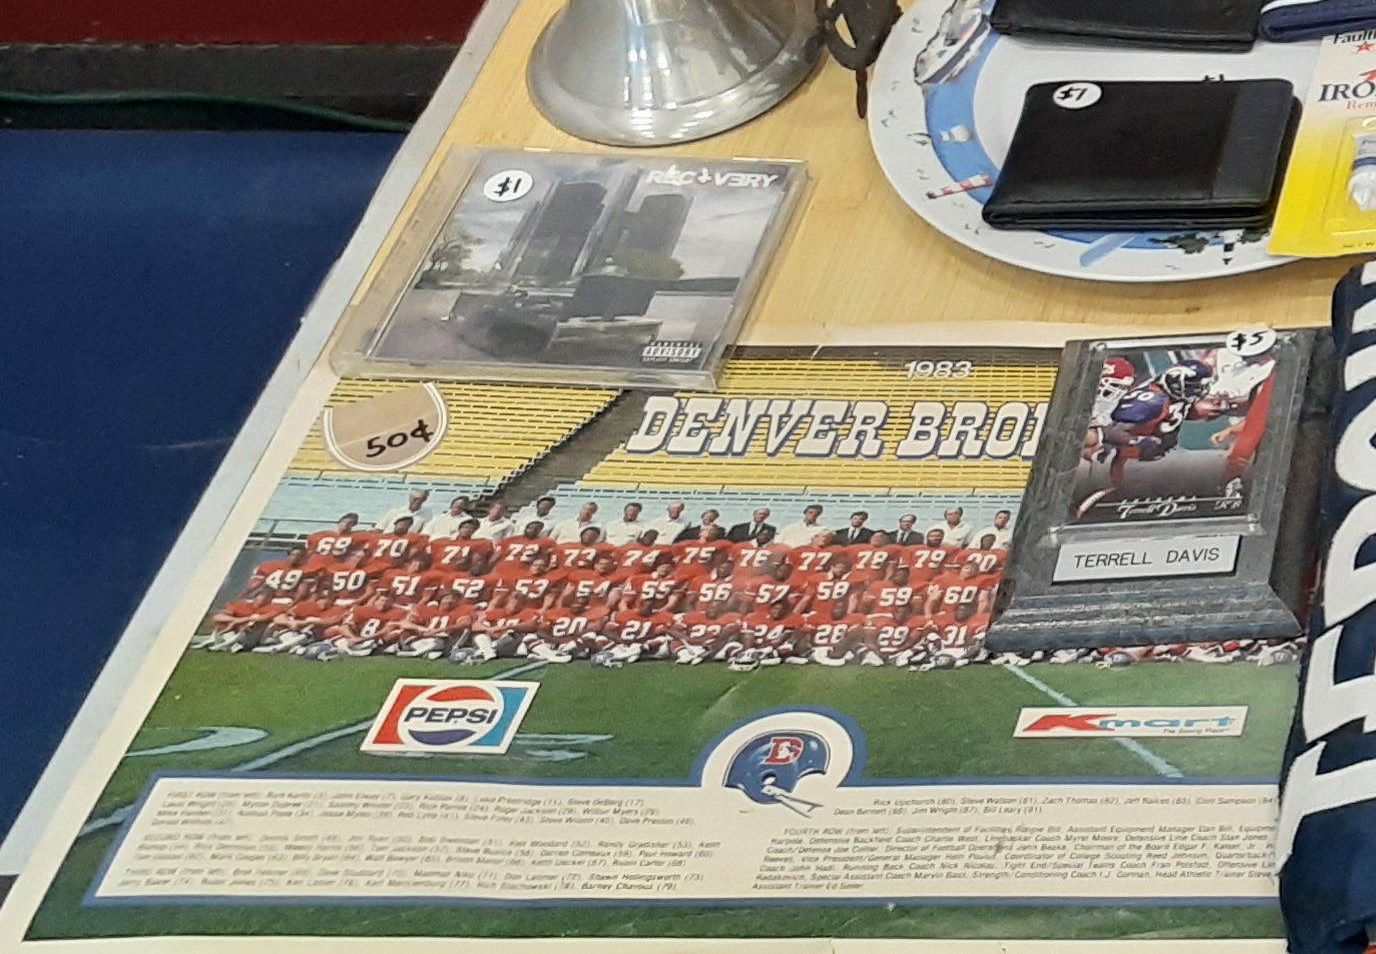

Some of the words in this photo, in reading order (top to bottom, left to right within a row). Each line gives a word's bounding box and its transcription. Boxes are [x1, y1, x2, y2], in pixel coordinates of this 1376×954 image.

[1060, 87, 1087, 104] $1
[493, 176, 522, 196] $1
[1232, 330, 1268, 351] $5
[904, 360, 972, 380] 1983
[627, 395, 887, 459] DENVER
[365, 419, 435, 458] 50¢
[1073, 550, 1153, 569] TERRELL
[1165, 547, 1221, 565] DAVIS
[404, 707, 498, 725] PEPSI
[1022, 713, 1239, 733] Kmart
